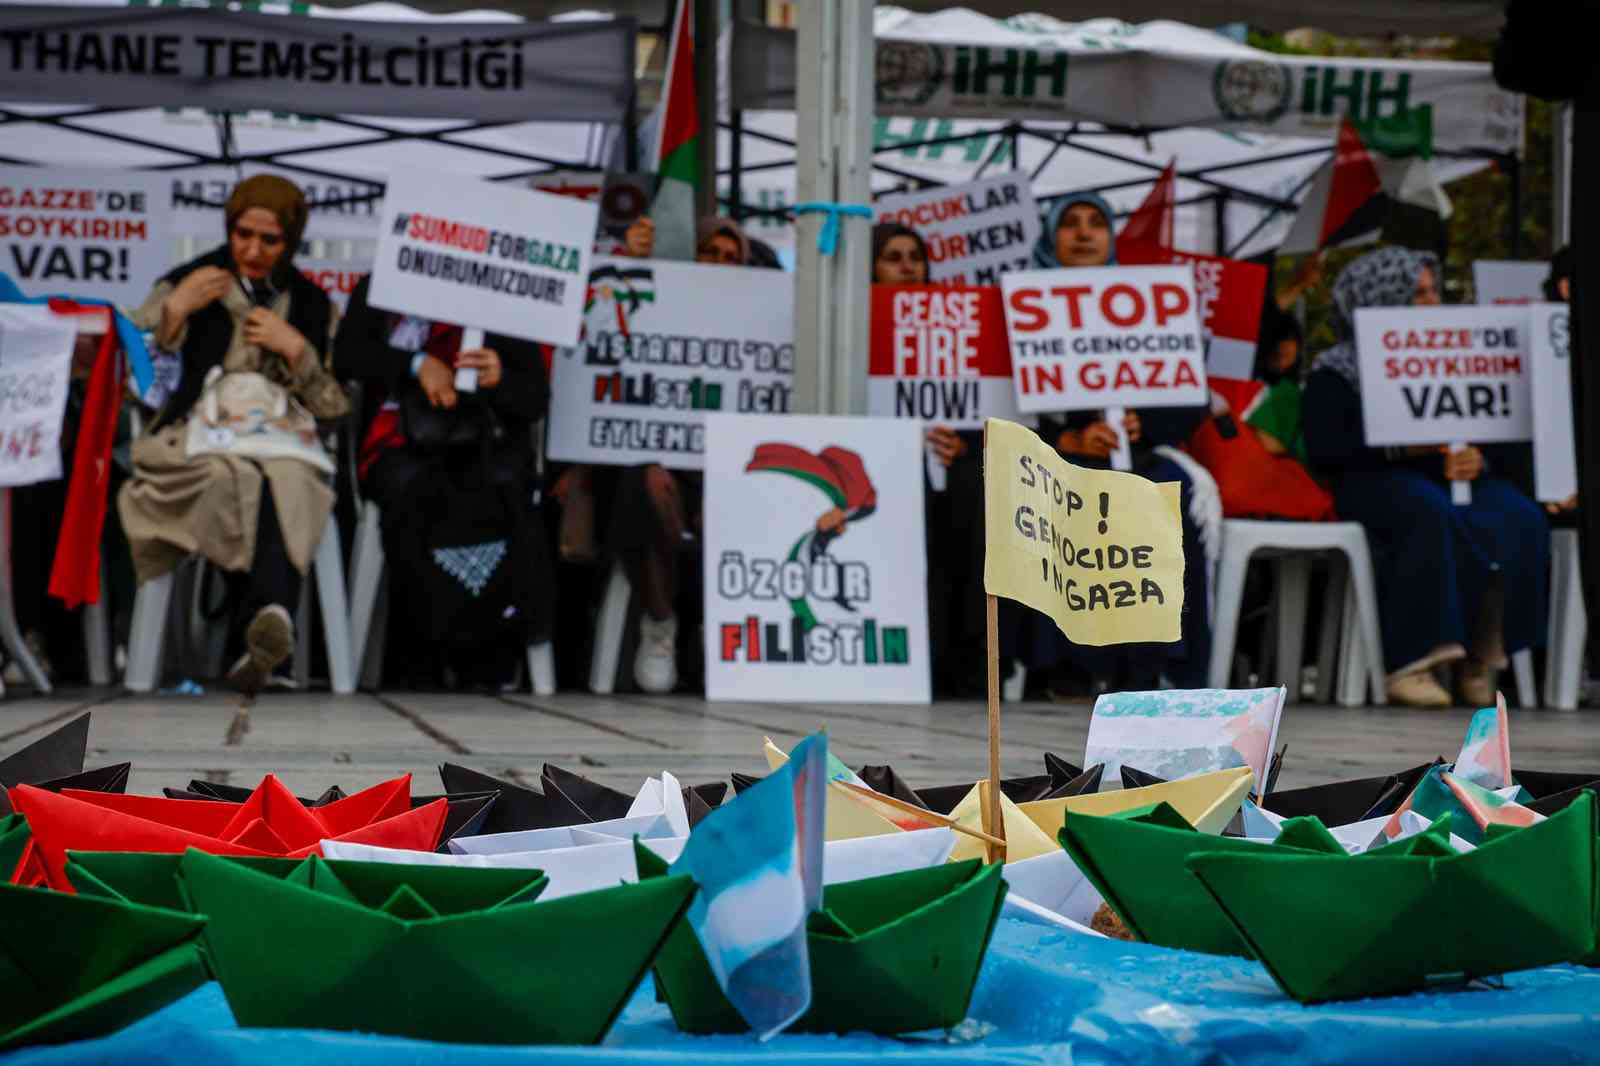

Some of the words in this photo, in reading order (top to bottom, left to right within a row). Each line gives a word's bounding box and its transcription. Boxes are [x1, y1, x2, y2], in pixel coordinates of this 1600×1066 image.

[2, 30, 181, 75] THANE
[0, 187, 146, 213] GAZZE'DE
[10, 243, 129, 283] VAR!
[393, 212, 580, 273] #SUMUDFORGAZA
[397, 245, 566, 305] ONURUMUZDUR!
[893, 290, 980, 328] CEASE
[1009, 283, 1191, 332] STOP
[894, 328, 980, 376] FIRE
[1016, 338, 1064, 356] THE
[1072, 333, 1197, 355] GENOCIDE
[1381, 327, 1518, 351] GAZZE'DE
[1019, 363, 1064, 395] IN
[1078, 360, 1200, 392] GAZA
[1384, 354, 1522, 379] SOYKIRIM
[895, 380, 979, 420] NOW!
[1402, 384, 1512, 419] VAR!
[1019, 455, 1084, 517] STOP
[1014, 505, 1154, 571] GENOCIDE
[718, 550, 871, 602] ÖZGÜR
[1041, 557, 1063, 595] IN
[1065, 577, 1165, 612] GAZA
